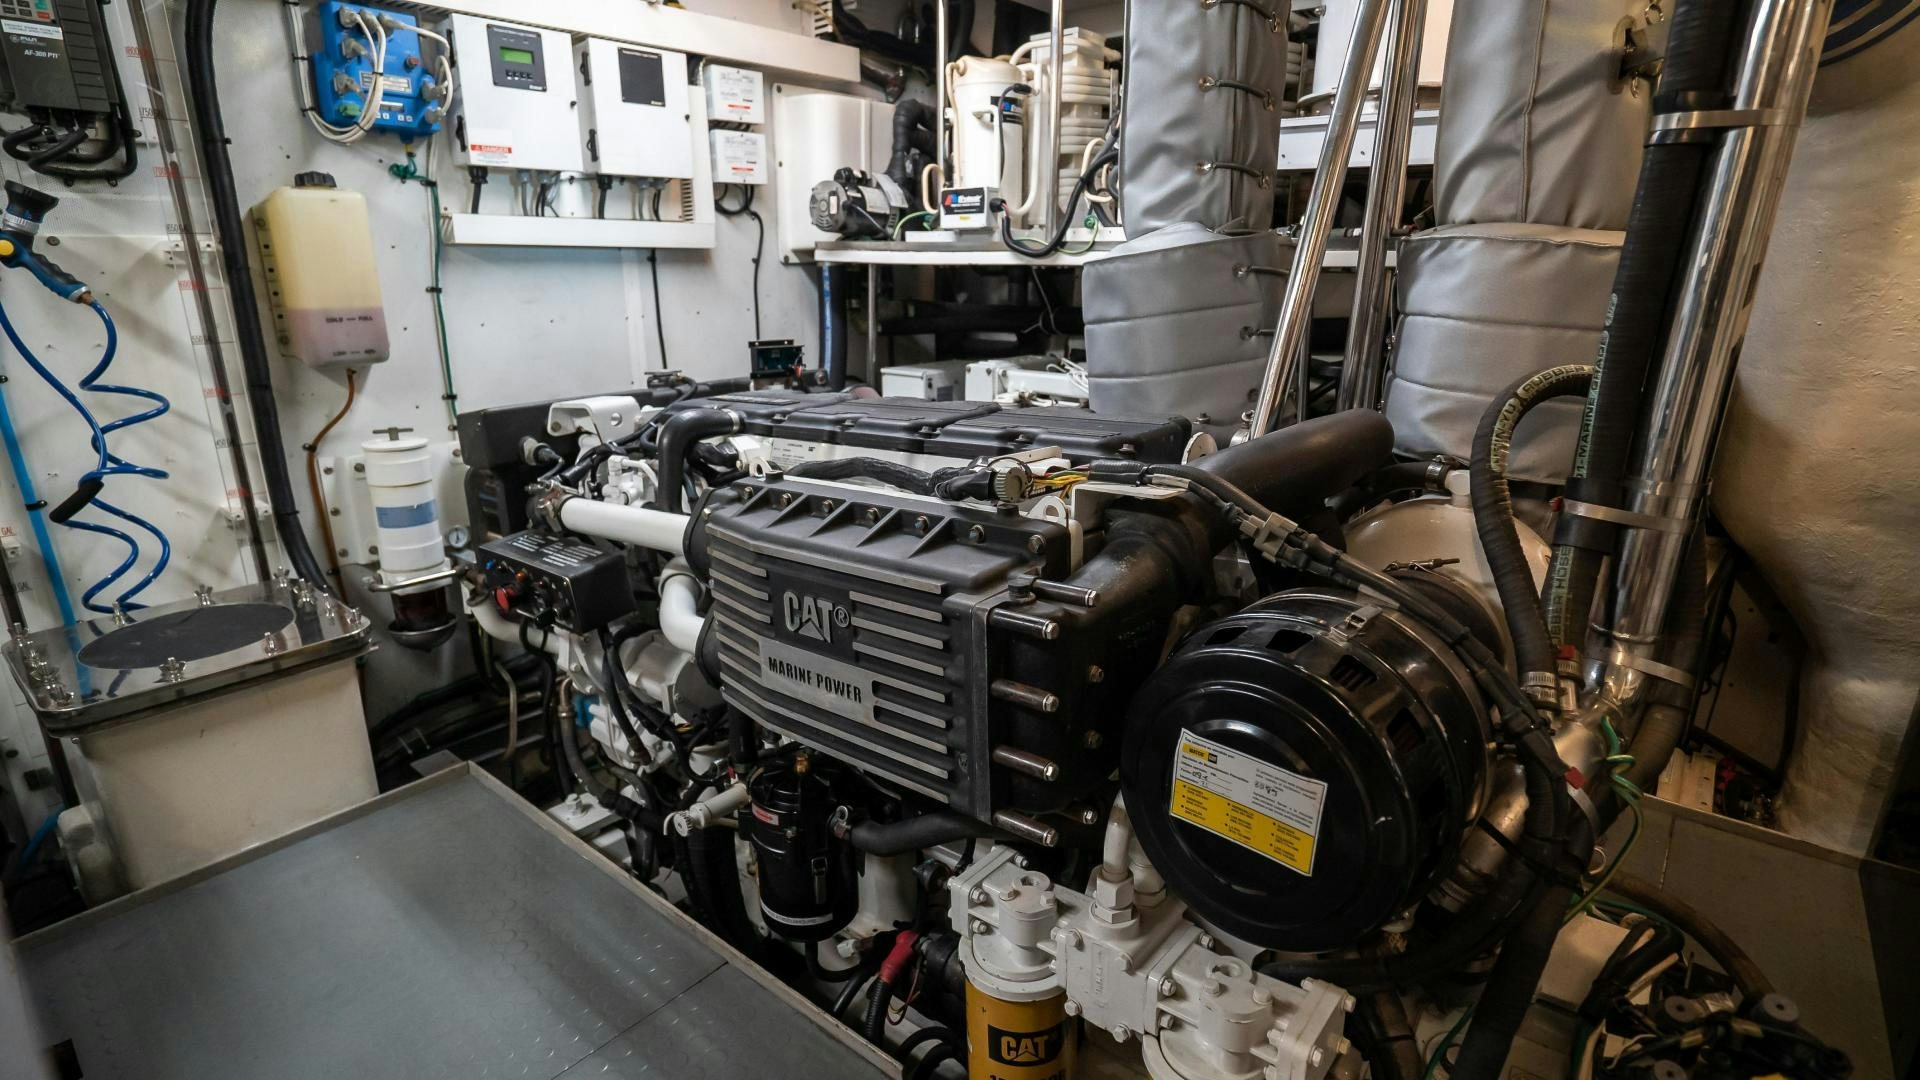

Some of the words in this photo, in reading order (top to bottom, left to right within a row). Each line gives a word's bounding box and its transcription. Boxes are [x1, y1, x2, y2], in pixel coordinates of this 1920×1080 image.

[1522, 366, 1585, 393] RUBBER
[1555, 545, 1573, 590] HOSE
[768, 656, 812, 685] MARINE
[816, 672, 862, 703] POWER
[1000, 1035, 1049, 1061] CAT
